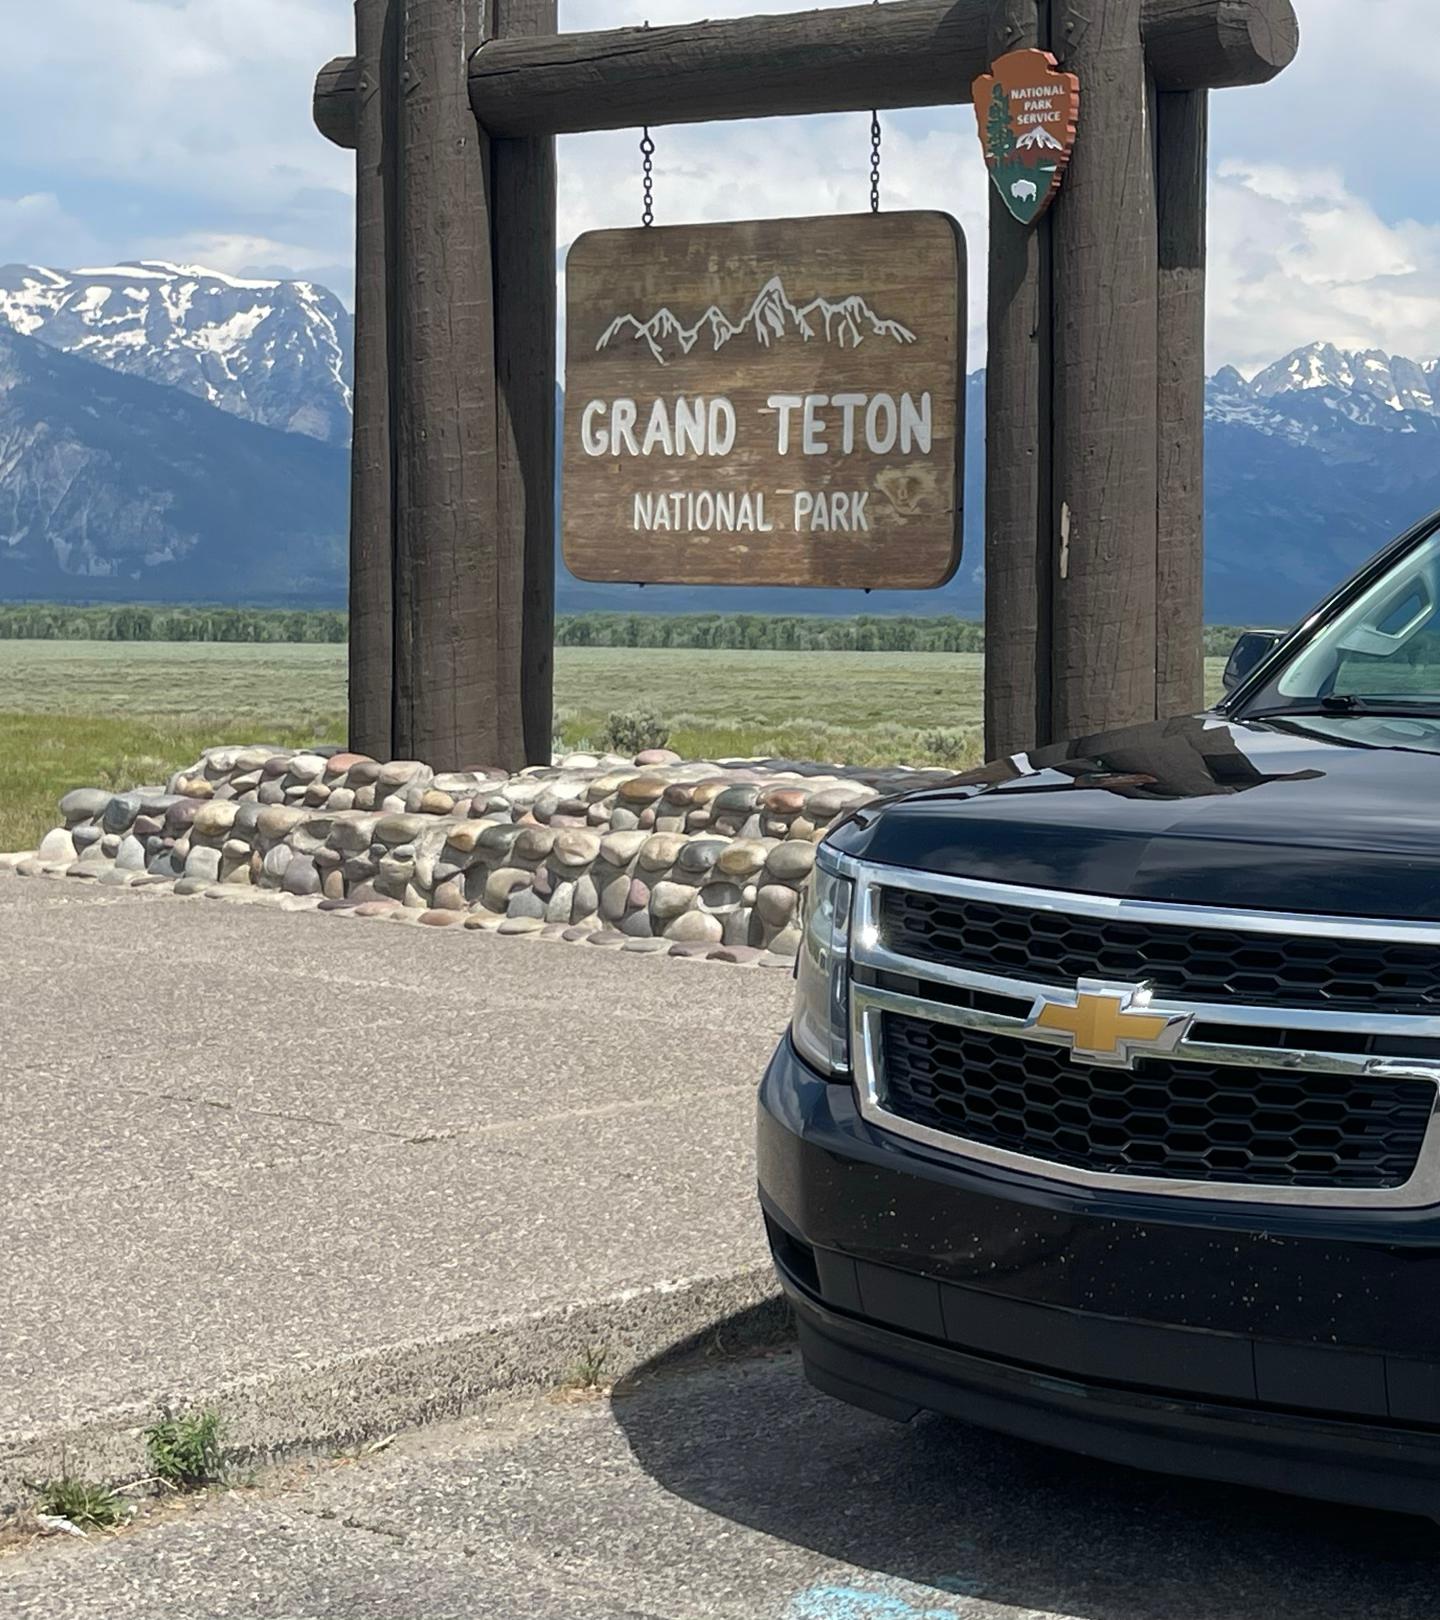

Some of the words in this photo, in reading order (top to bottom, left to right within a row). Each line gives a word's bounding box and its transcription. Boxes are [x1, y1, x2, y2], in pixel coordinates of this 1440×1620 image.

[1011, 85, 1065, 99] NATIONAL
[1024, 99, 1052, 111] PARK
[1017, 111, 1061, 125] SERVICE
[581, 396, 737, 457] GRAND
[766, 391, 932, 455] TETON
[633, 491, 773, 532] NATIONAL
[794, 489, 870, 532] PARK
